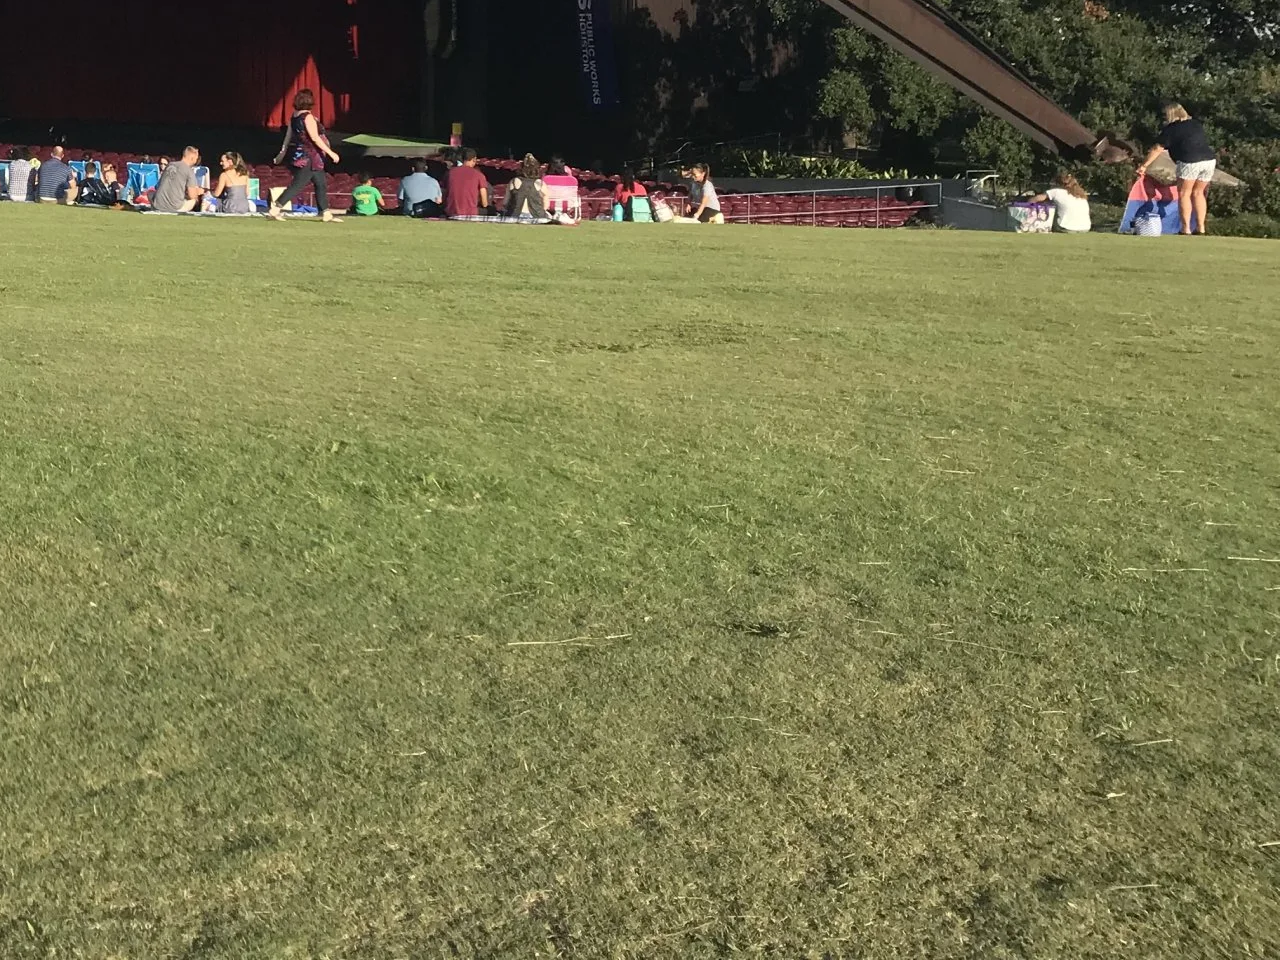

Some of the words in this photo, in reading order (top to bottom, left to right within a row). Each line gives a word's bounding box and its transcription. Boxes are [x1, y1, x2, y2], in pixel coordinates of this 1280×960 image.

[579, 13, 590, 72] HOUSTON
[586, 13, 596, 57] PUBLIC
[589, 60, 601, 105] WORKS
